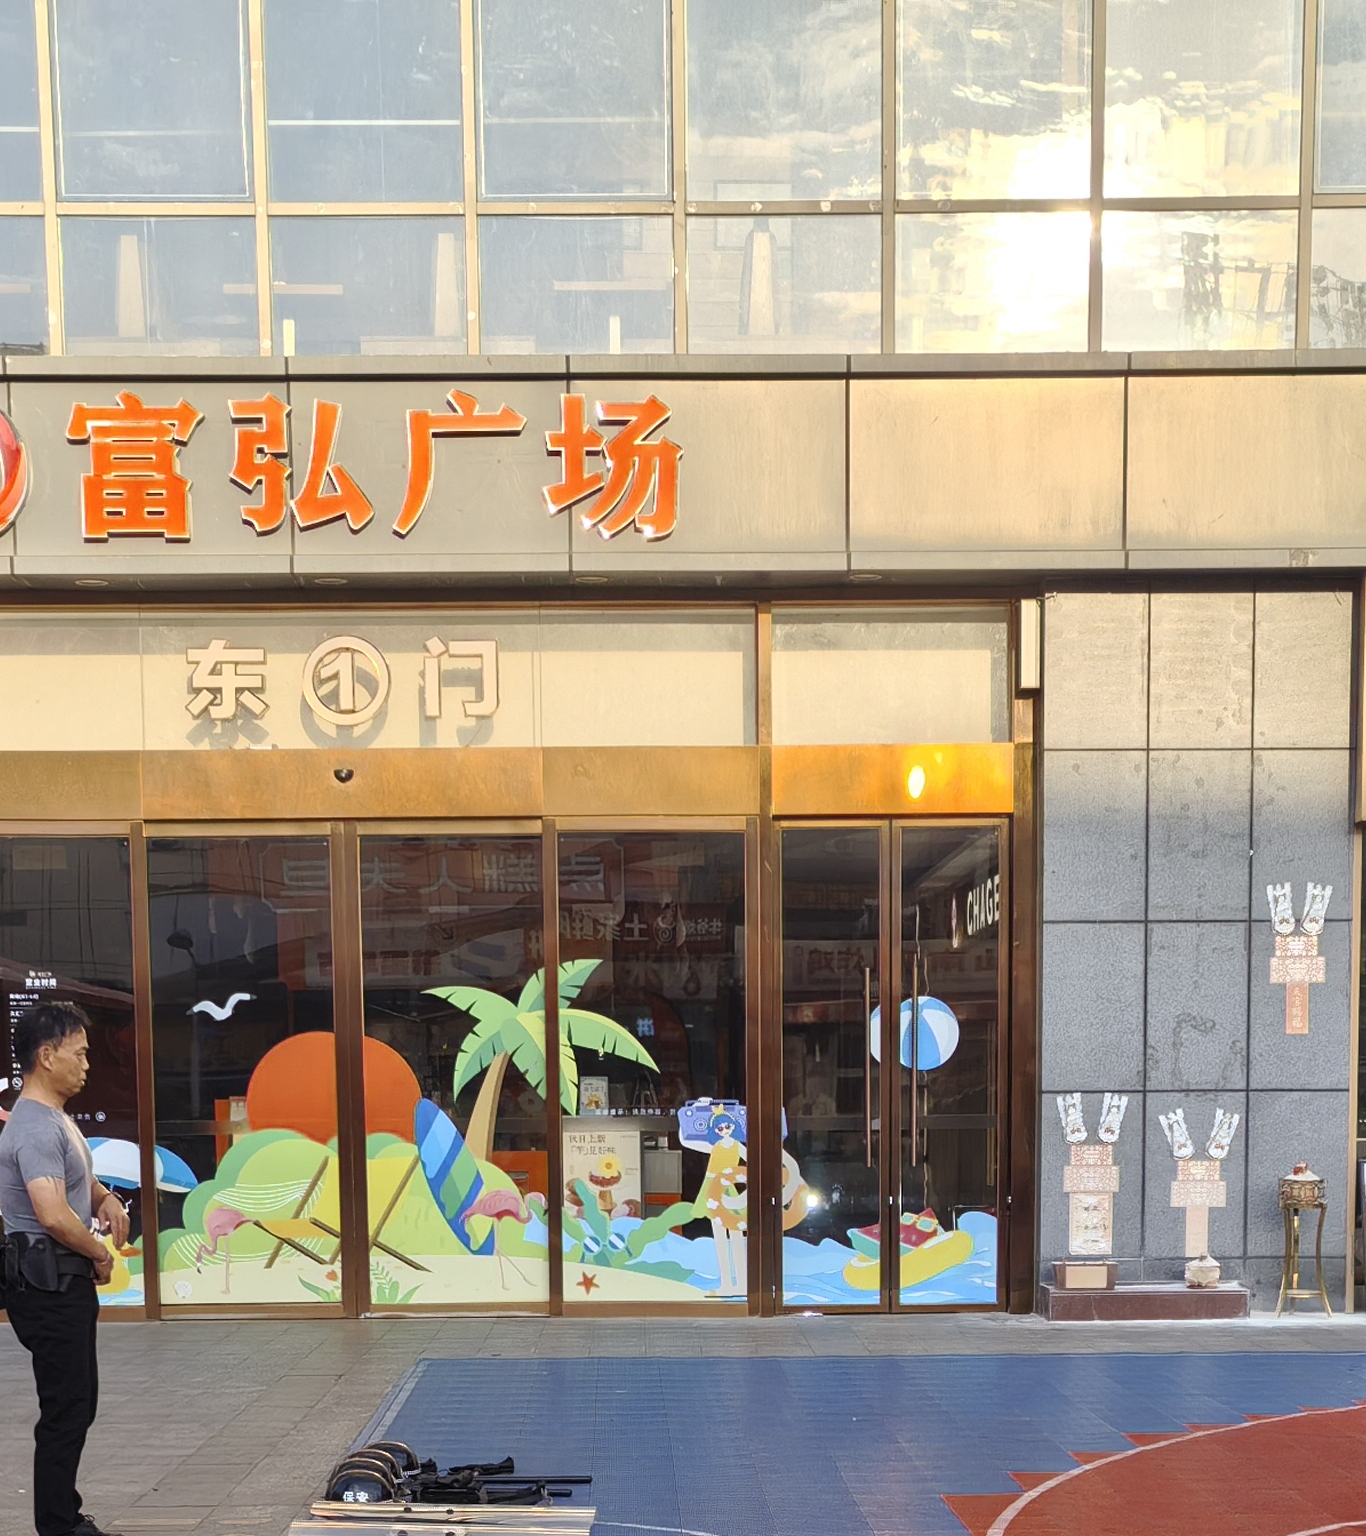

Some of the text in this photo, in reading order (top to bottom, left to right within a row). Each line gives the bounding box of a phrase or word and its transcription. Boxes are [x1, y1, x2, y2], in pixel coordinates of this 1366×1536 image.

[66, 389, 683, 542] 富弘广场
[342, 1491, 369, 1503] 保安
